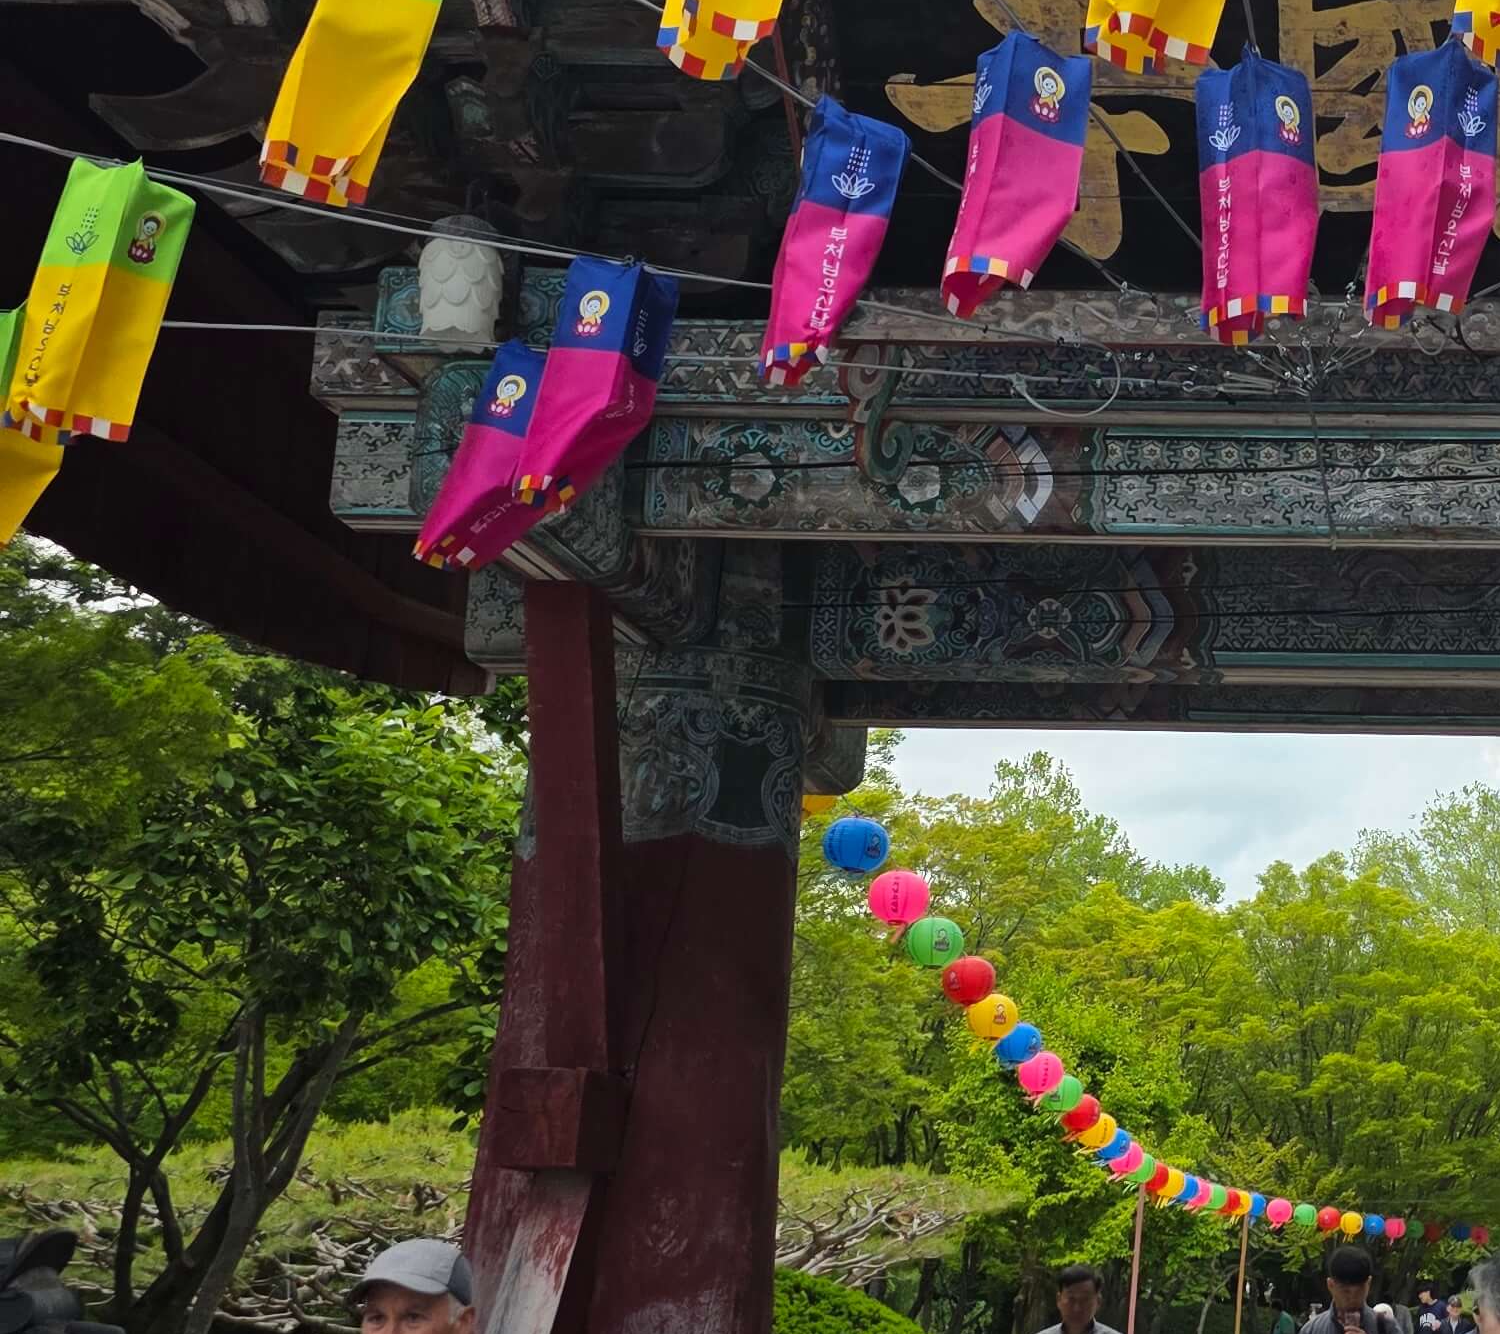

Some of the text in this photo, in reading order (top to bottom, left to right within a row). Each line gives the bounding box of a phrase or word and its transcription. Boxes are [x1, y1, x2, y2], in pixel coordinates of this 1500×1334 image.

[1217, 175, 1232, 289] 부처님오신날
[1432, 163, 1472, 276] 부처님오신날
[810, 227, 848, 331] 부처님오신날
